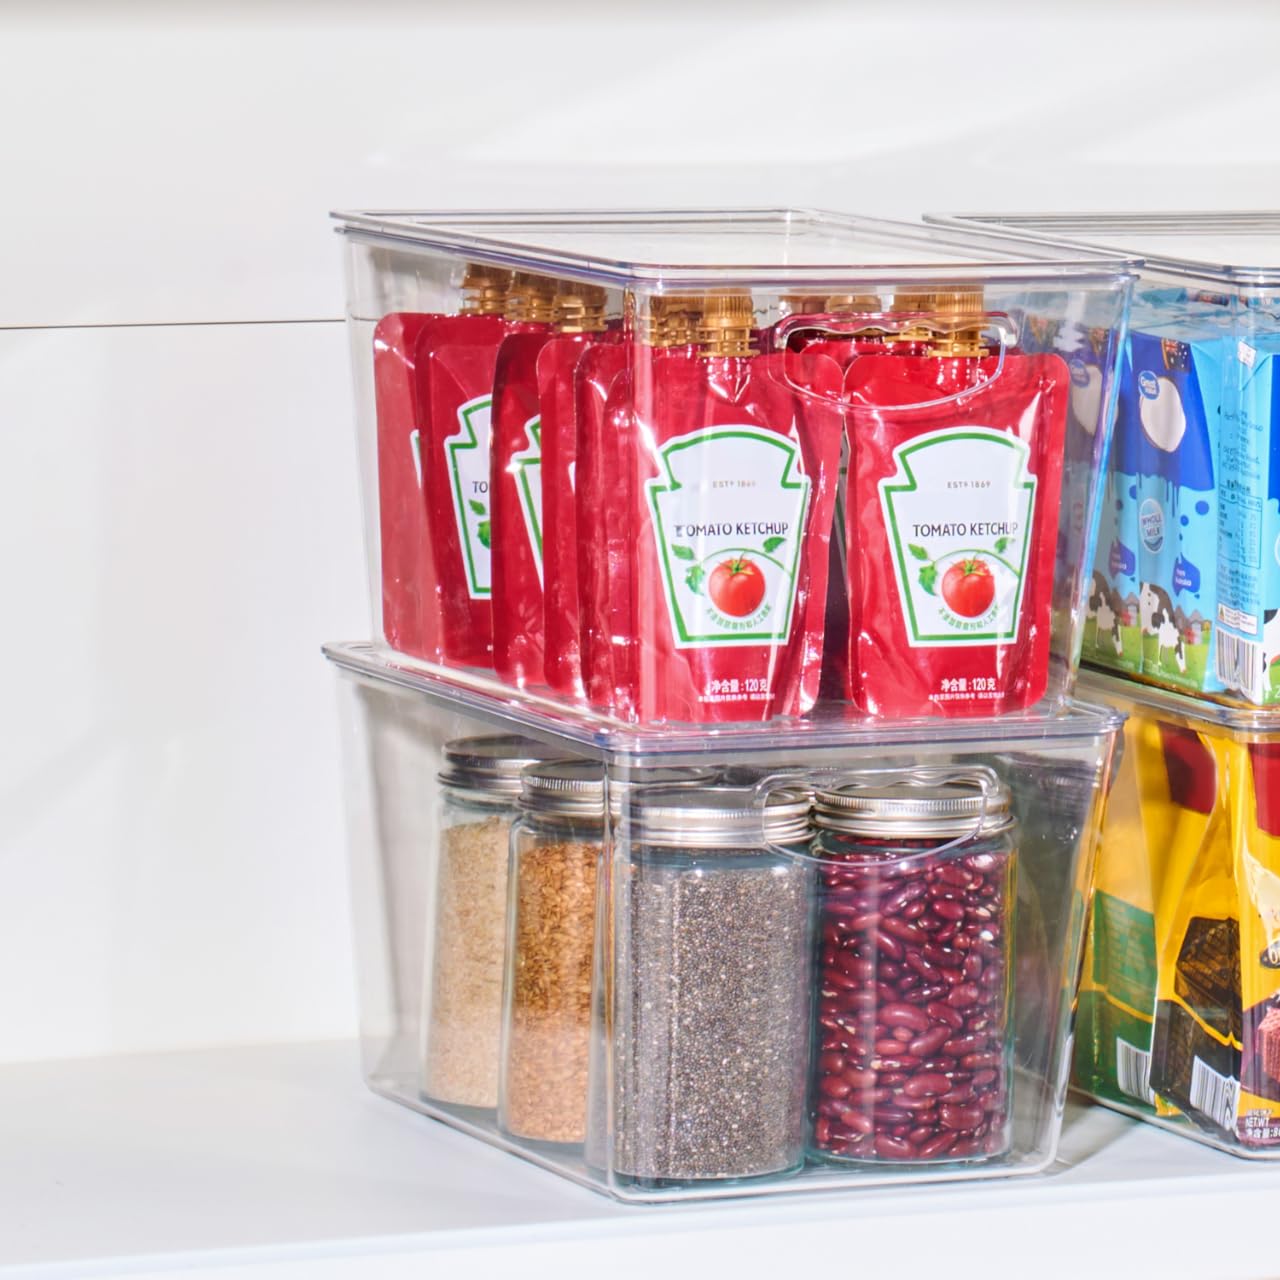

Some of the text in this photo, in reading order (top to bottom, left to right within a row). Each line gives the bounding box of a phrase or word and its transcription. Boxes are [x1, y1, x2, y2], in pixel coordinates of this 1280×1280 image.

[675, 522, 789, 537] TOMATO KETCHUP
[913, 522, 1018, 537] TOMATO KETCHUP
[711, 678, 768, 693] 净含量:120克
[941, 678, 996, 692] 净含量:120克
